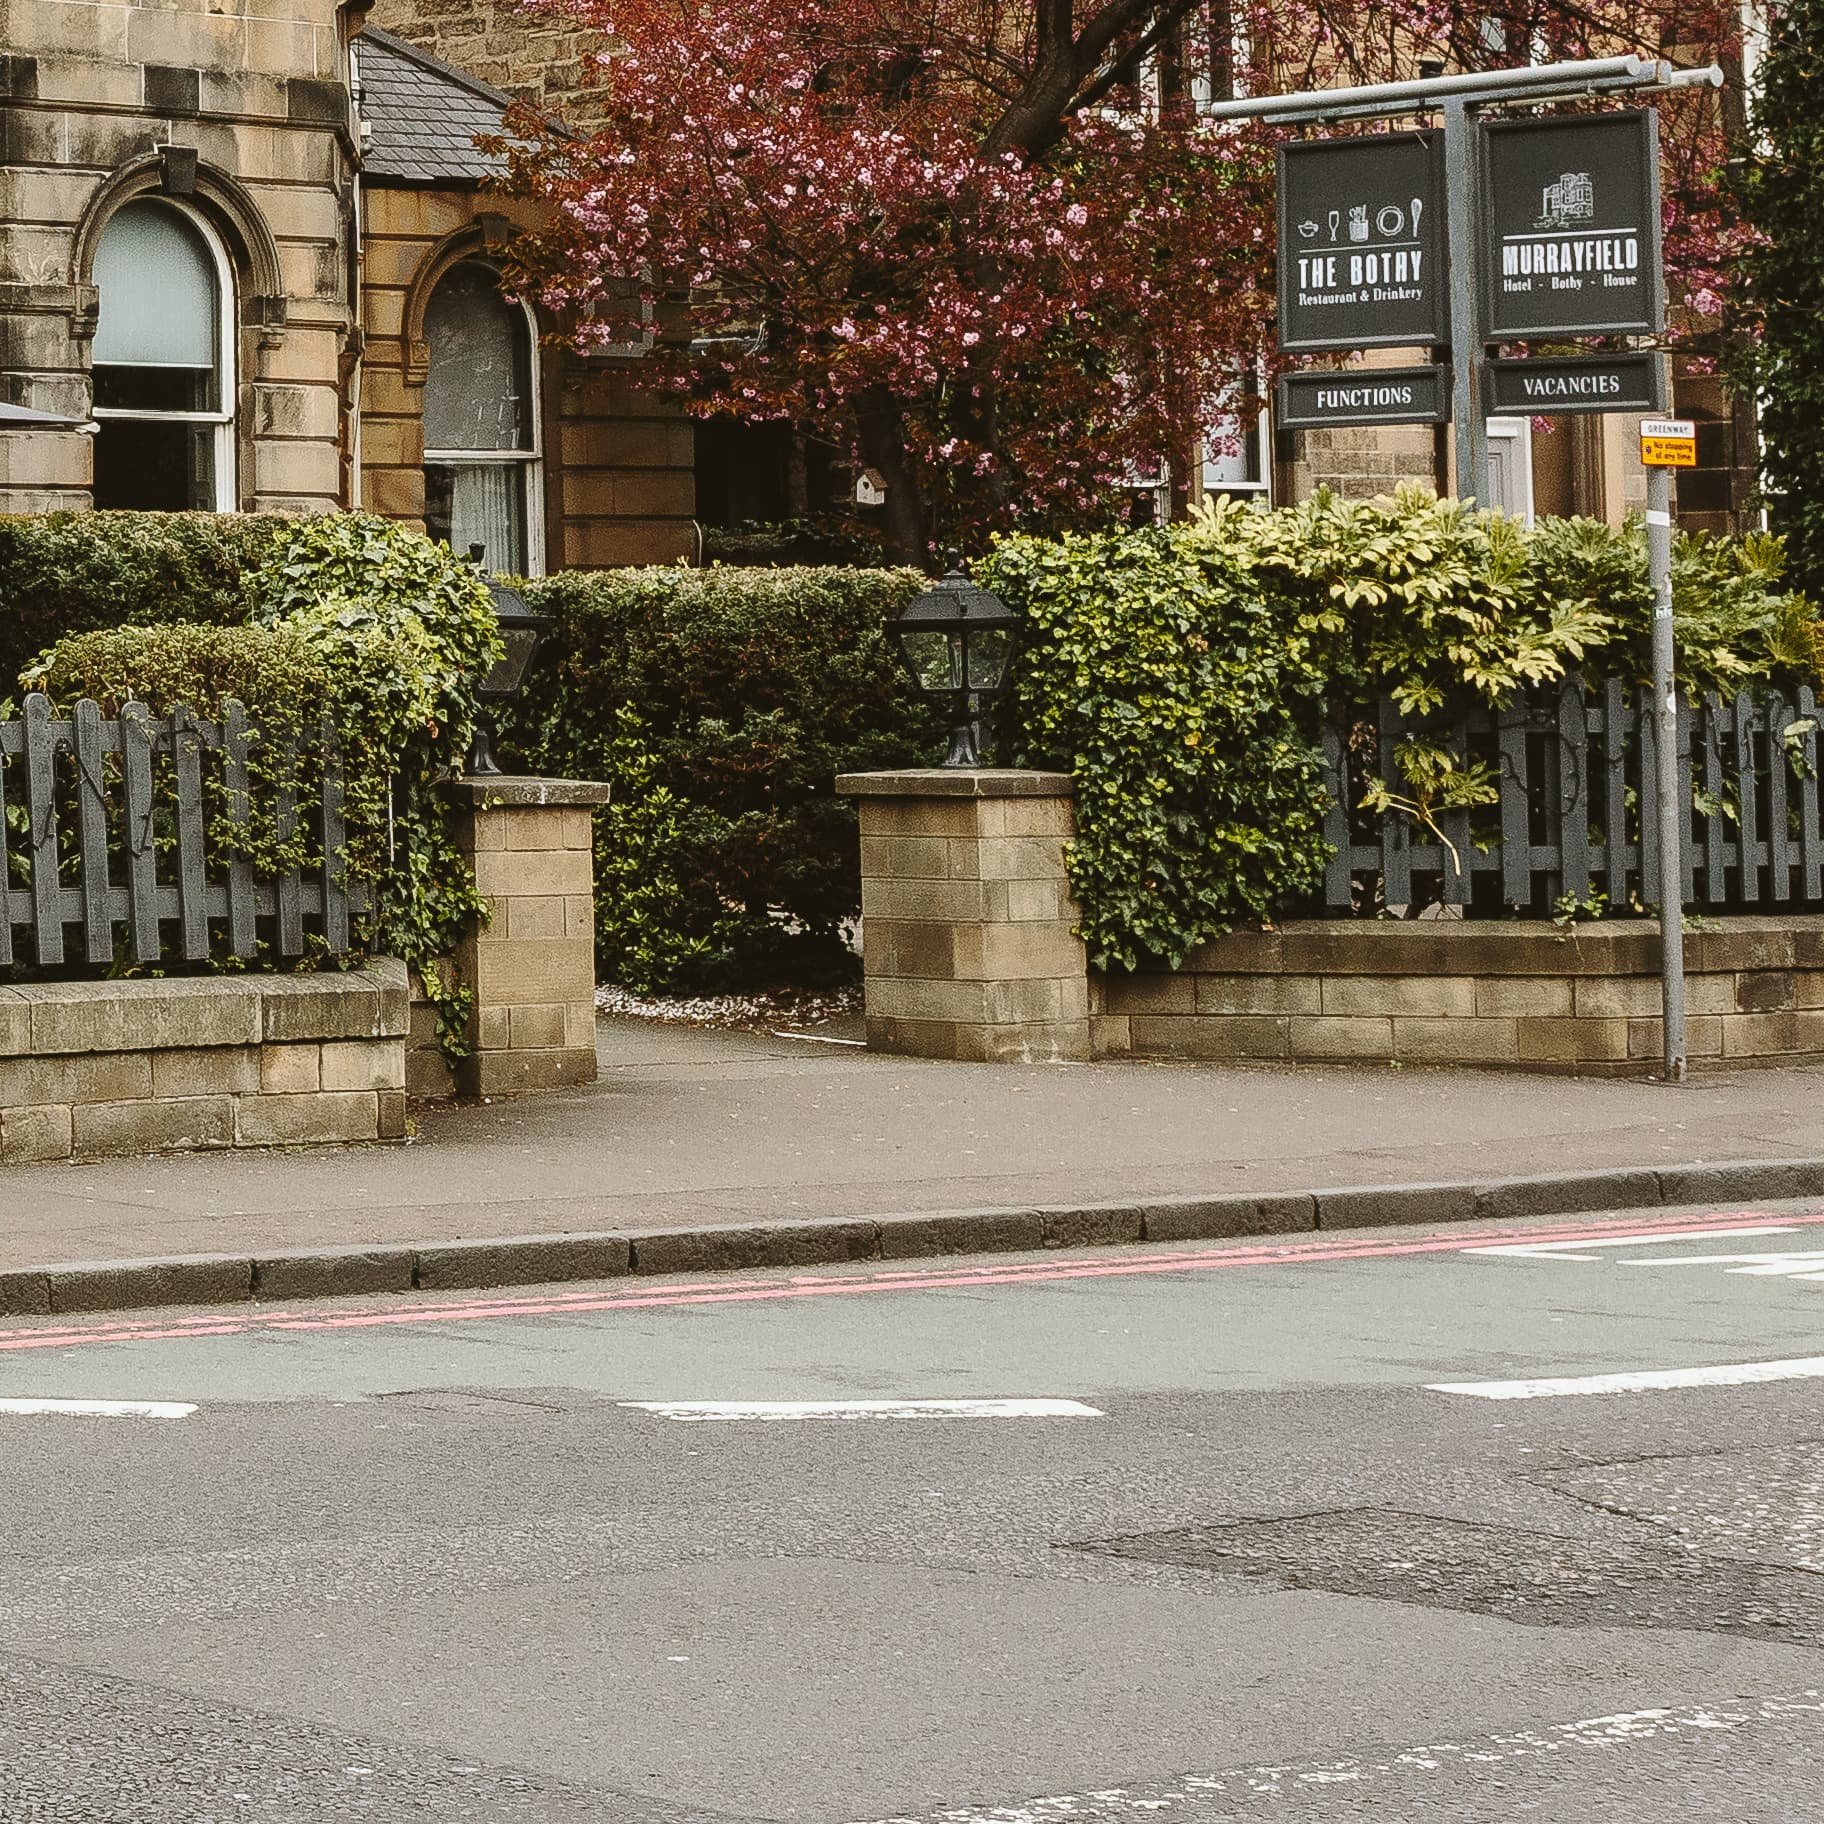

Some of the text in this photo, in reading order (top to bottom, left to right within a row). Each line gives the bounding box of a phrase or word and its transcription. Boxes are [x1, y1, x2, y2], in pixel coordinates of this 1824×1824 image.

[1502, 238, 1638, 276] MURRAYFIELD
[1298, 250, 1422, 289] THE BOTHY
[1503, 278, 1532, 292] Hotel
[1551, 275, 1583, 290] Bothy
[1603, 273, 1638, 288] House
[1298, 286, 1423, 306] Restaurant & Drinkery
[1524, 375, 1620, 396] VACANCIES
[1317, 387, 1413, 409] FUNCTIONS
[1648, 425, 1689, 434] GREENWAY
